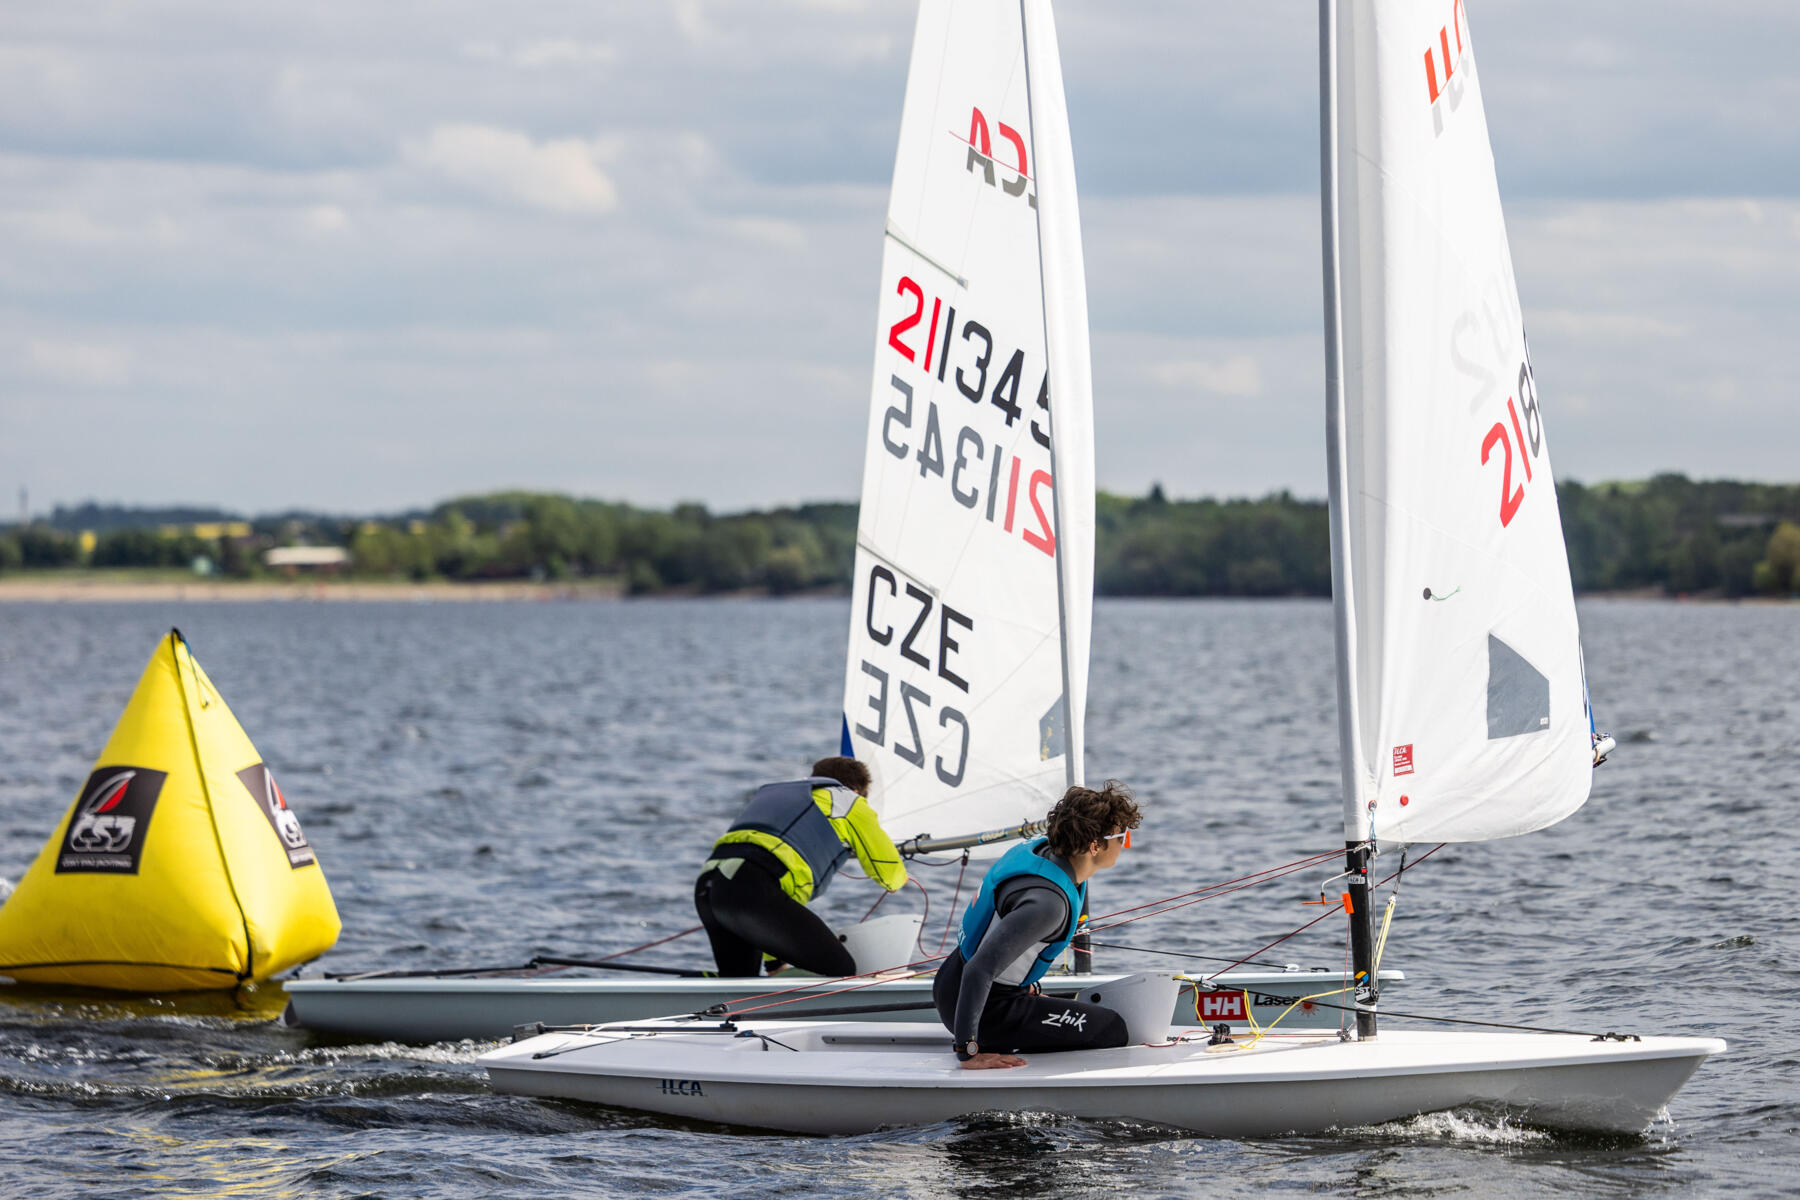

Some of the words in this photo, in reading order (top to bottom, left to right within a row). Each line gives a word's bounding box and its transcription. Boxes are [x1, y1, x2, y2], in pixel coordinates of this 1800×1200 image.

[866, 565, 973, 694] CZE
[1203, 996, 1242, 1016] HH
[661, 1079, 704, 1097] ILCA
